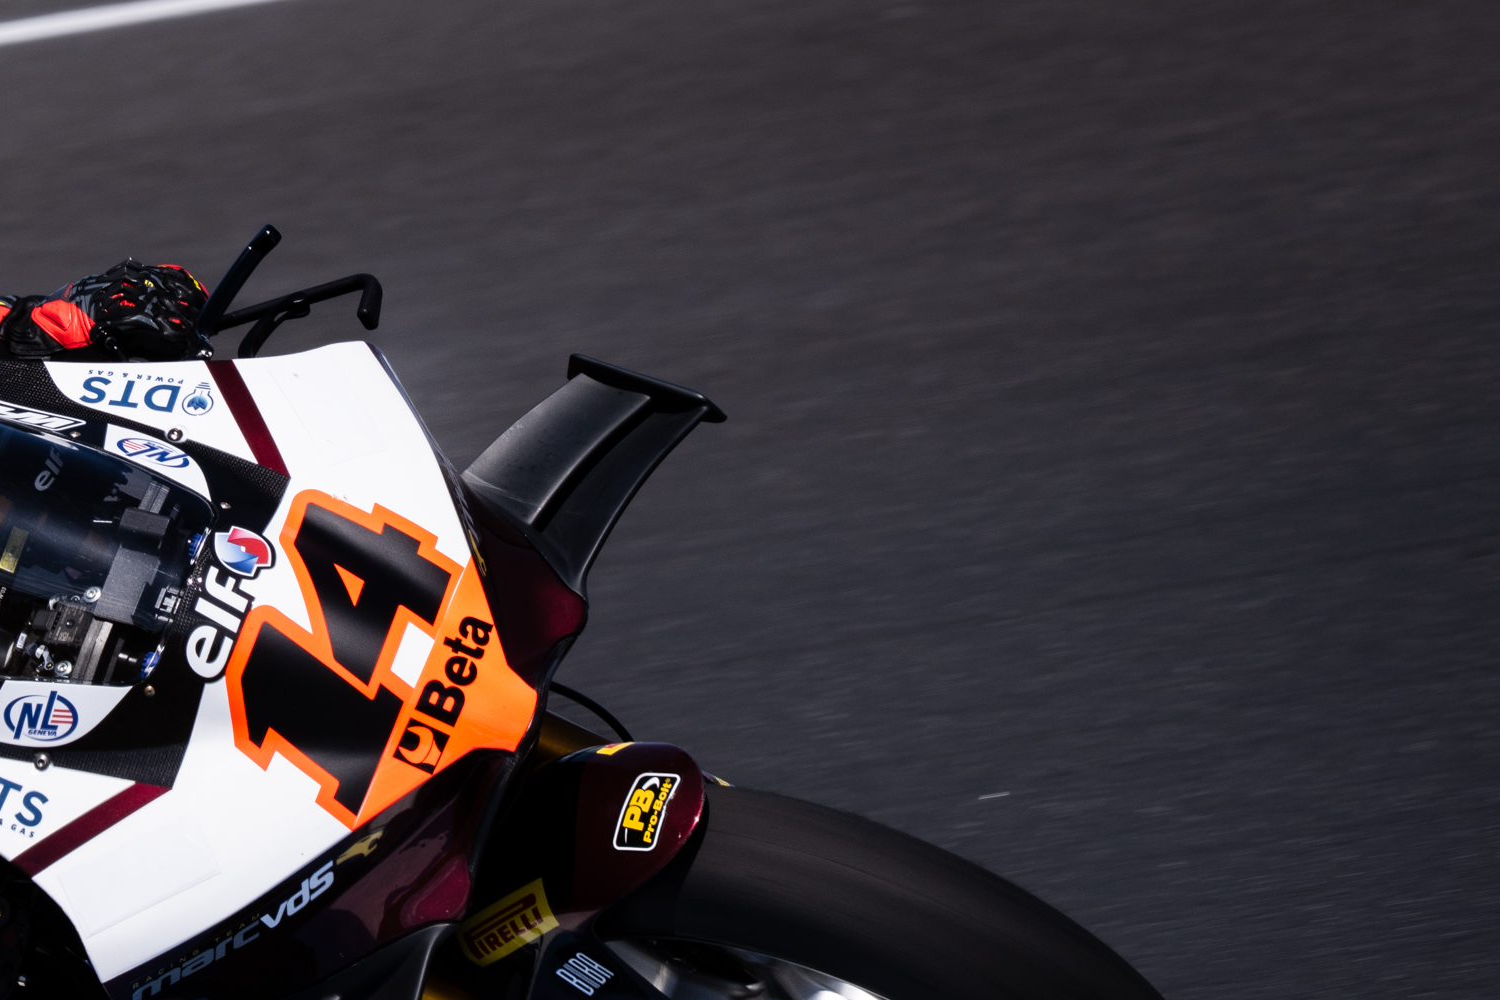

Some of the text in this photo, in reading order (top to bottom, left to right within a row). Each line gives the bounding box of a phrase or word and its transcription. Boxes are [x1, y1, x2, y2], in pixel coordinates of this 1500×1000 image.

[79, 376, 181, 413] DTS
[235, 497, 456, 822] 14
[415, 616, 493, 727] Beta
[13, 690, 59, 740] NL
[28, 729, 57, 737] GENEVA
[11, 824, 35, 838] GAS
[622, 788, 655, 831] PB
[132, 912, 260, 989] RACING TEAM
[462, 893, 544, 960] PIRELLI
